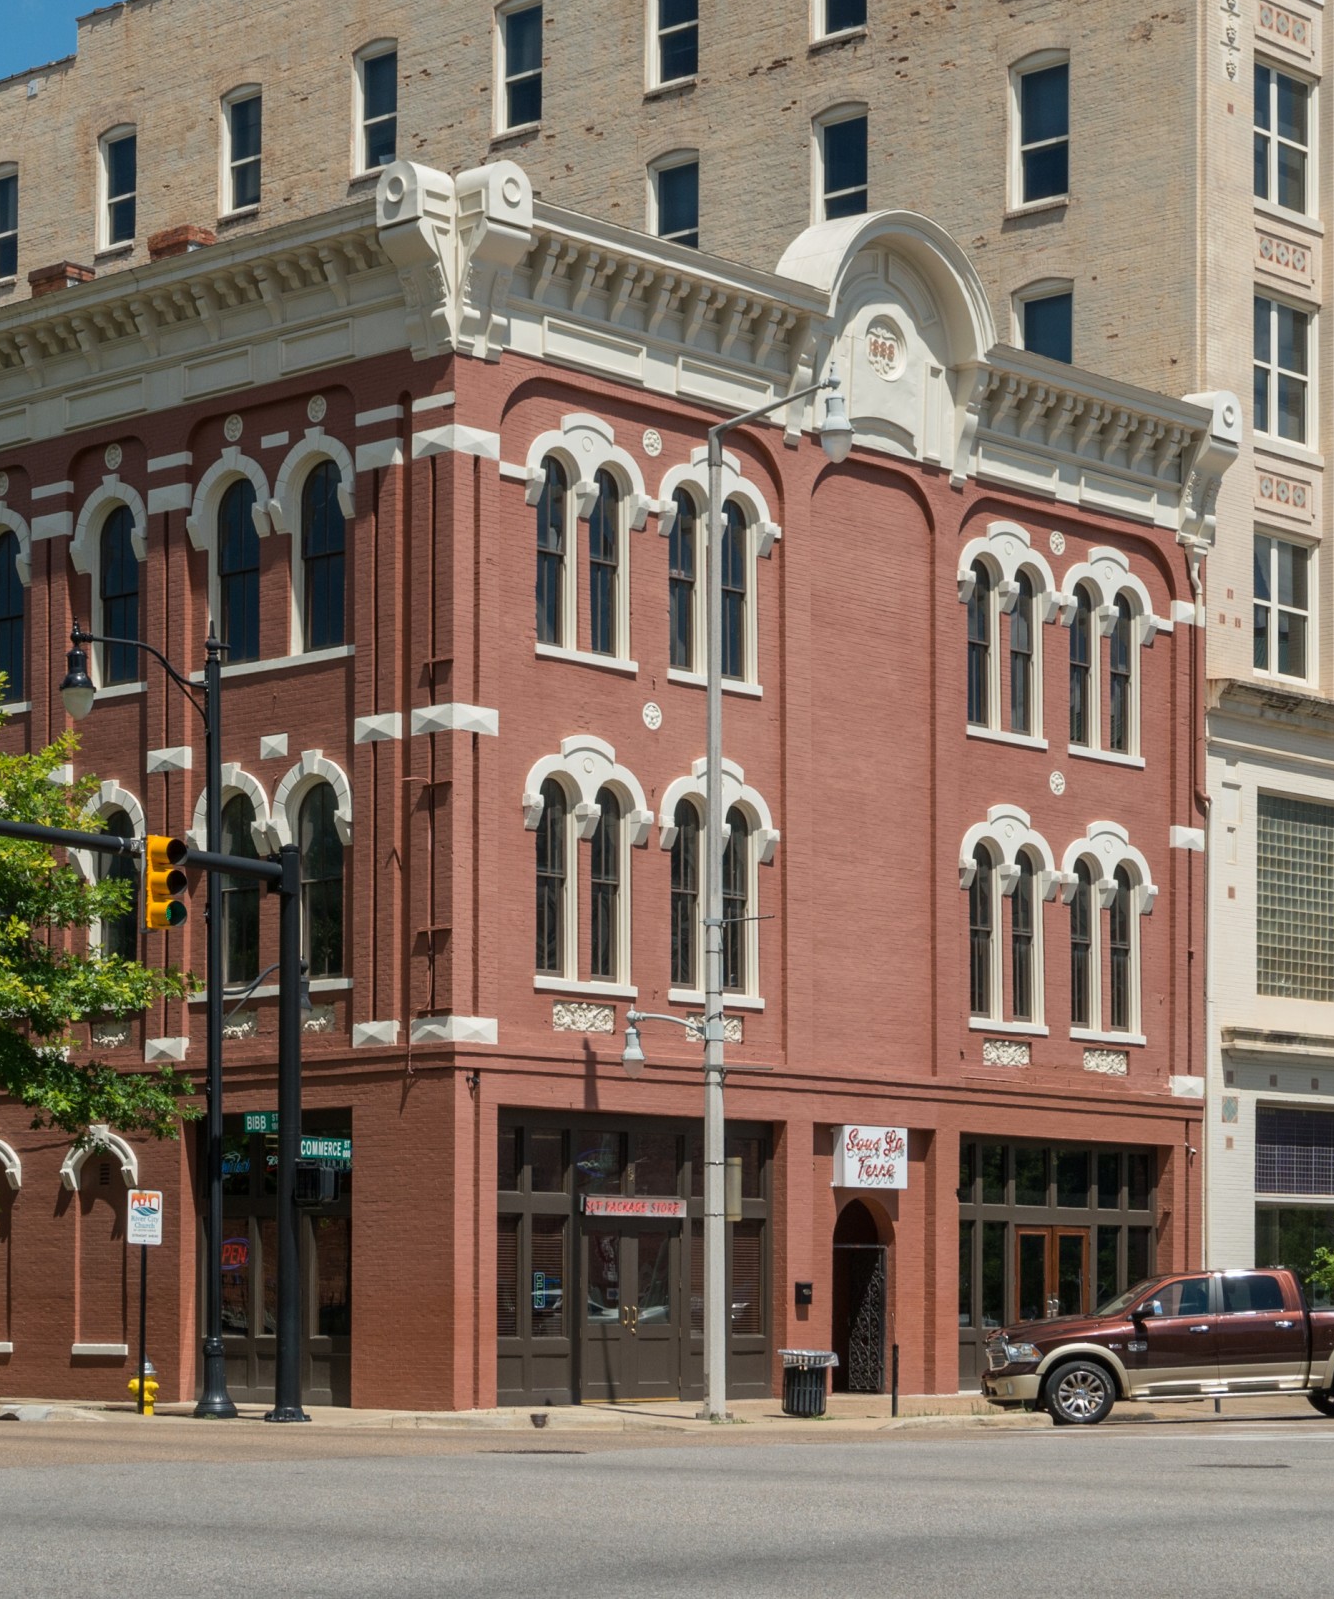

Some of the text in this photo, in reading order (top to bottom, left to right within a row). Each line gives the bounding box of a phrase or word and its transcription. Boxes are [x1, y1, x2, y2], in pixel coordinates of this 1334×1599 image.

[247, 1113, 279, 1131] BIBB ST
[300, 1140, 351, 1157] COMMERCE ST
[846, 1128, 882, 1153] Sous
[858, 1155, 895, 1179] Terre
[605, 1201, 649, 1213] PACKAGE
[650, 1202, 681, 1214] STORE
[148, 1216, 159, 1224] City
[221, 1244, 248, 1265] PEN
[535, 1274, 544, 1307] OPEN
